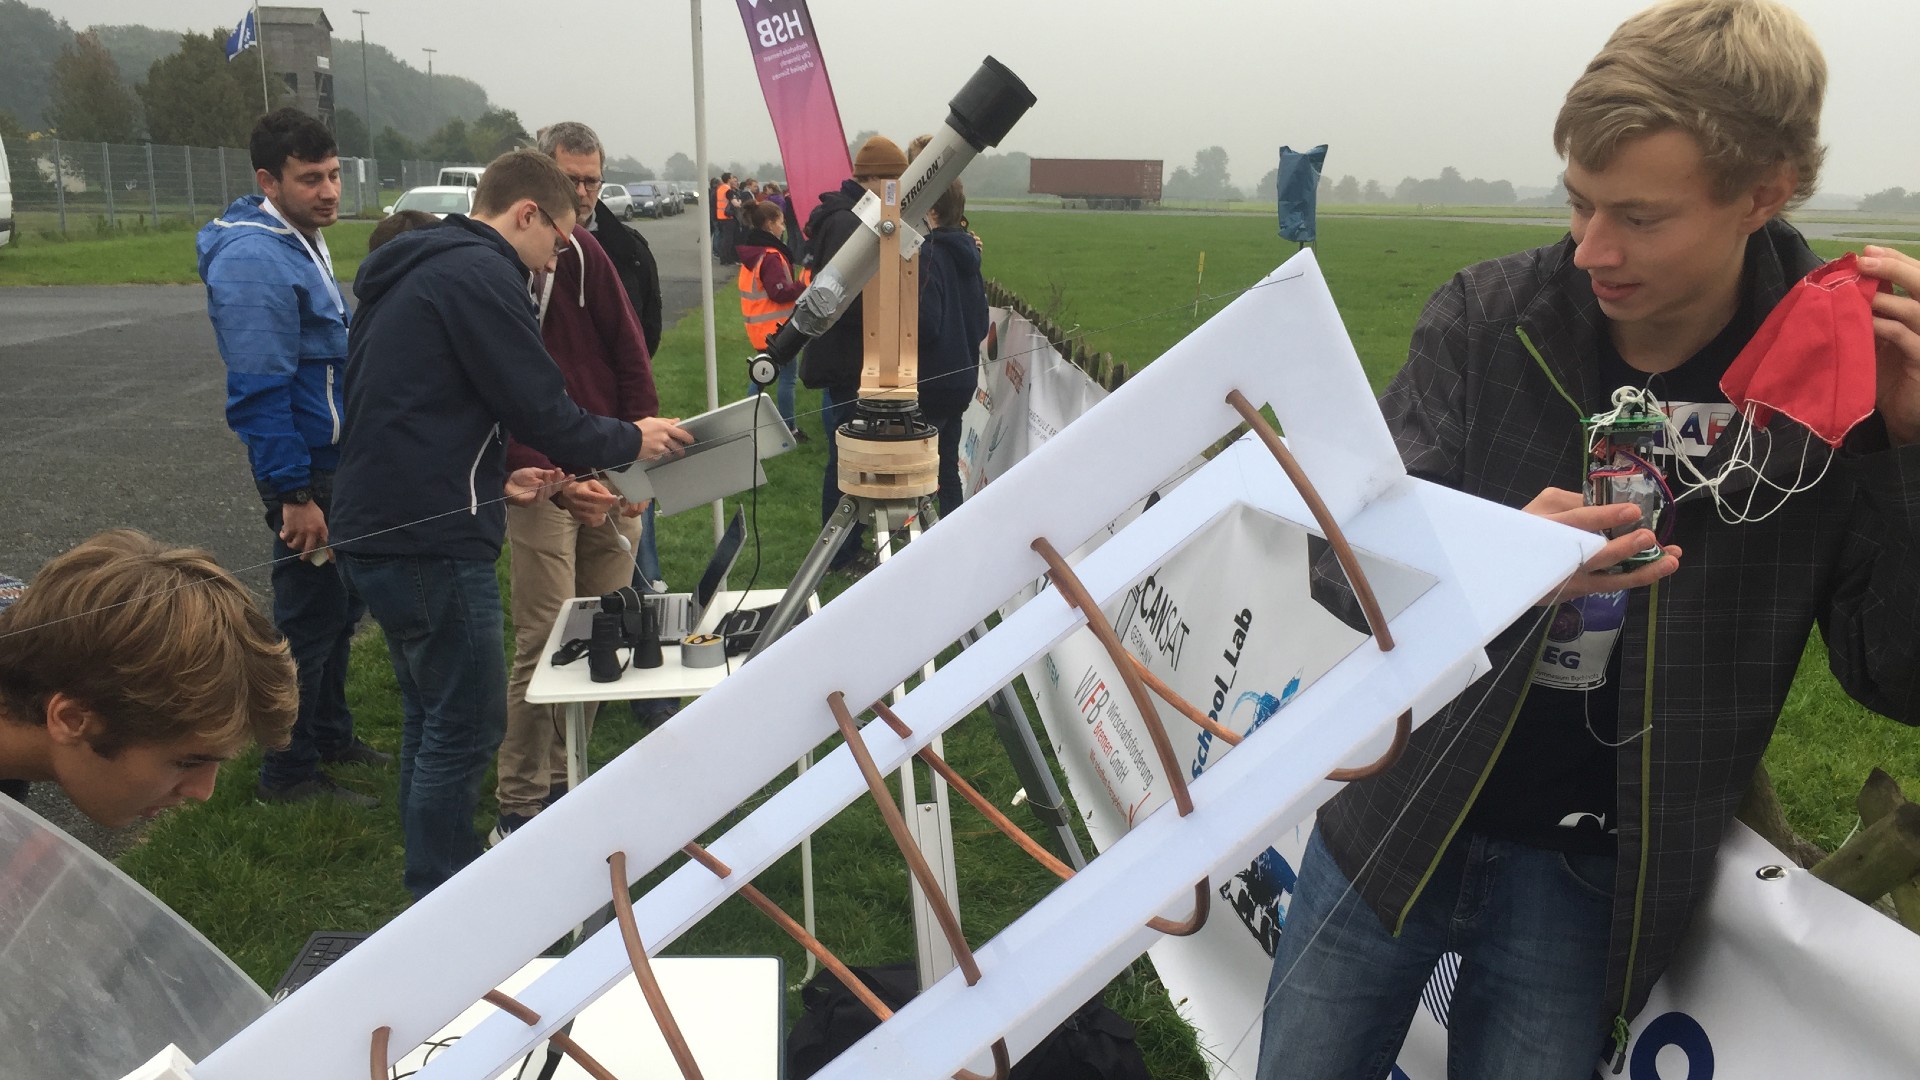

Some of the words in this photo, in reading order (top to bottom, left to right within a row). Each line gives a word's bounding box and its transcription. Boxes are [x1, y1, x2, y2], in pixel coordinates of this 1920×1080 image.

[900, 159, 939, 212] STROLON
[1130, 625, 1153, 669] GERMANY
[1139, 575, 1190, 671] CANSAT
[1541, 645, 1581, 669] EG
[1074, 665, 1110, 725] WFB
[1093, 720, 1113, 757] Bremen
[1110, 749, 1129, 784] GmbH
[1106, 700, 1154, 791] Wirtschaftsförderung
